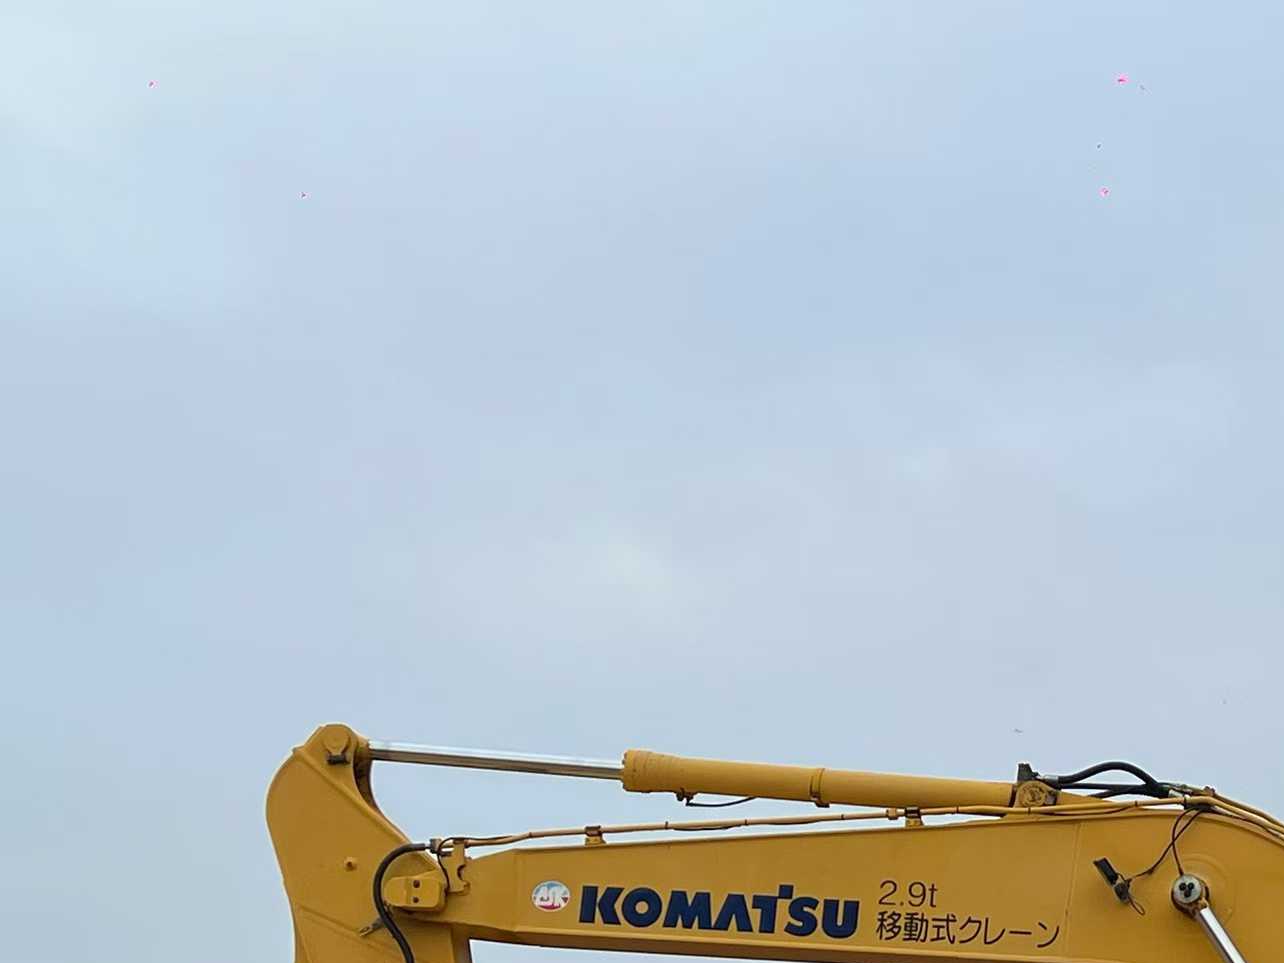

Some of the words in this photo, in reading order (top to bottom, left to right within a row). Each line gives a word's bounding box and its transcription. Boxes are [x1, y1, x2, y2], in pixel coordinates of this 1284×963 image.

[579, 884, 860, 939] KOMATSU
[878, 880, 938, 908] 2.9t
[876, 911, 1060, 948] 移動式クレーン
